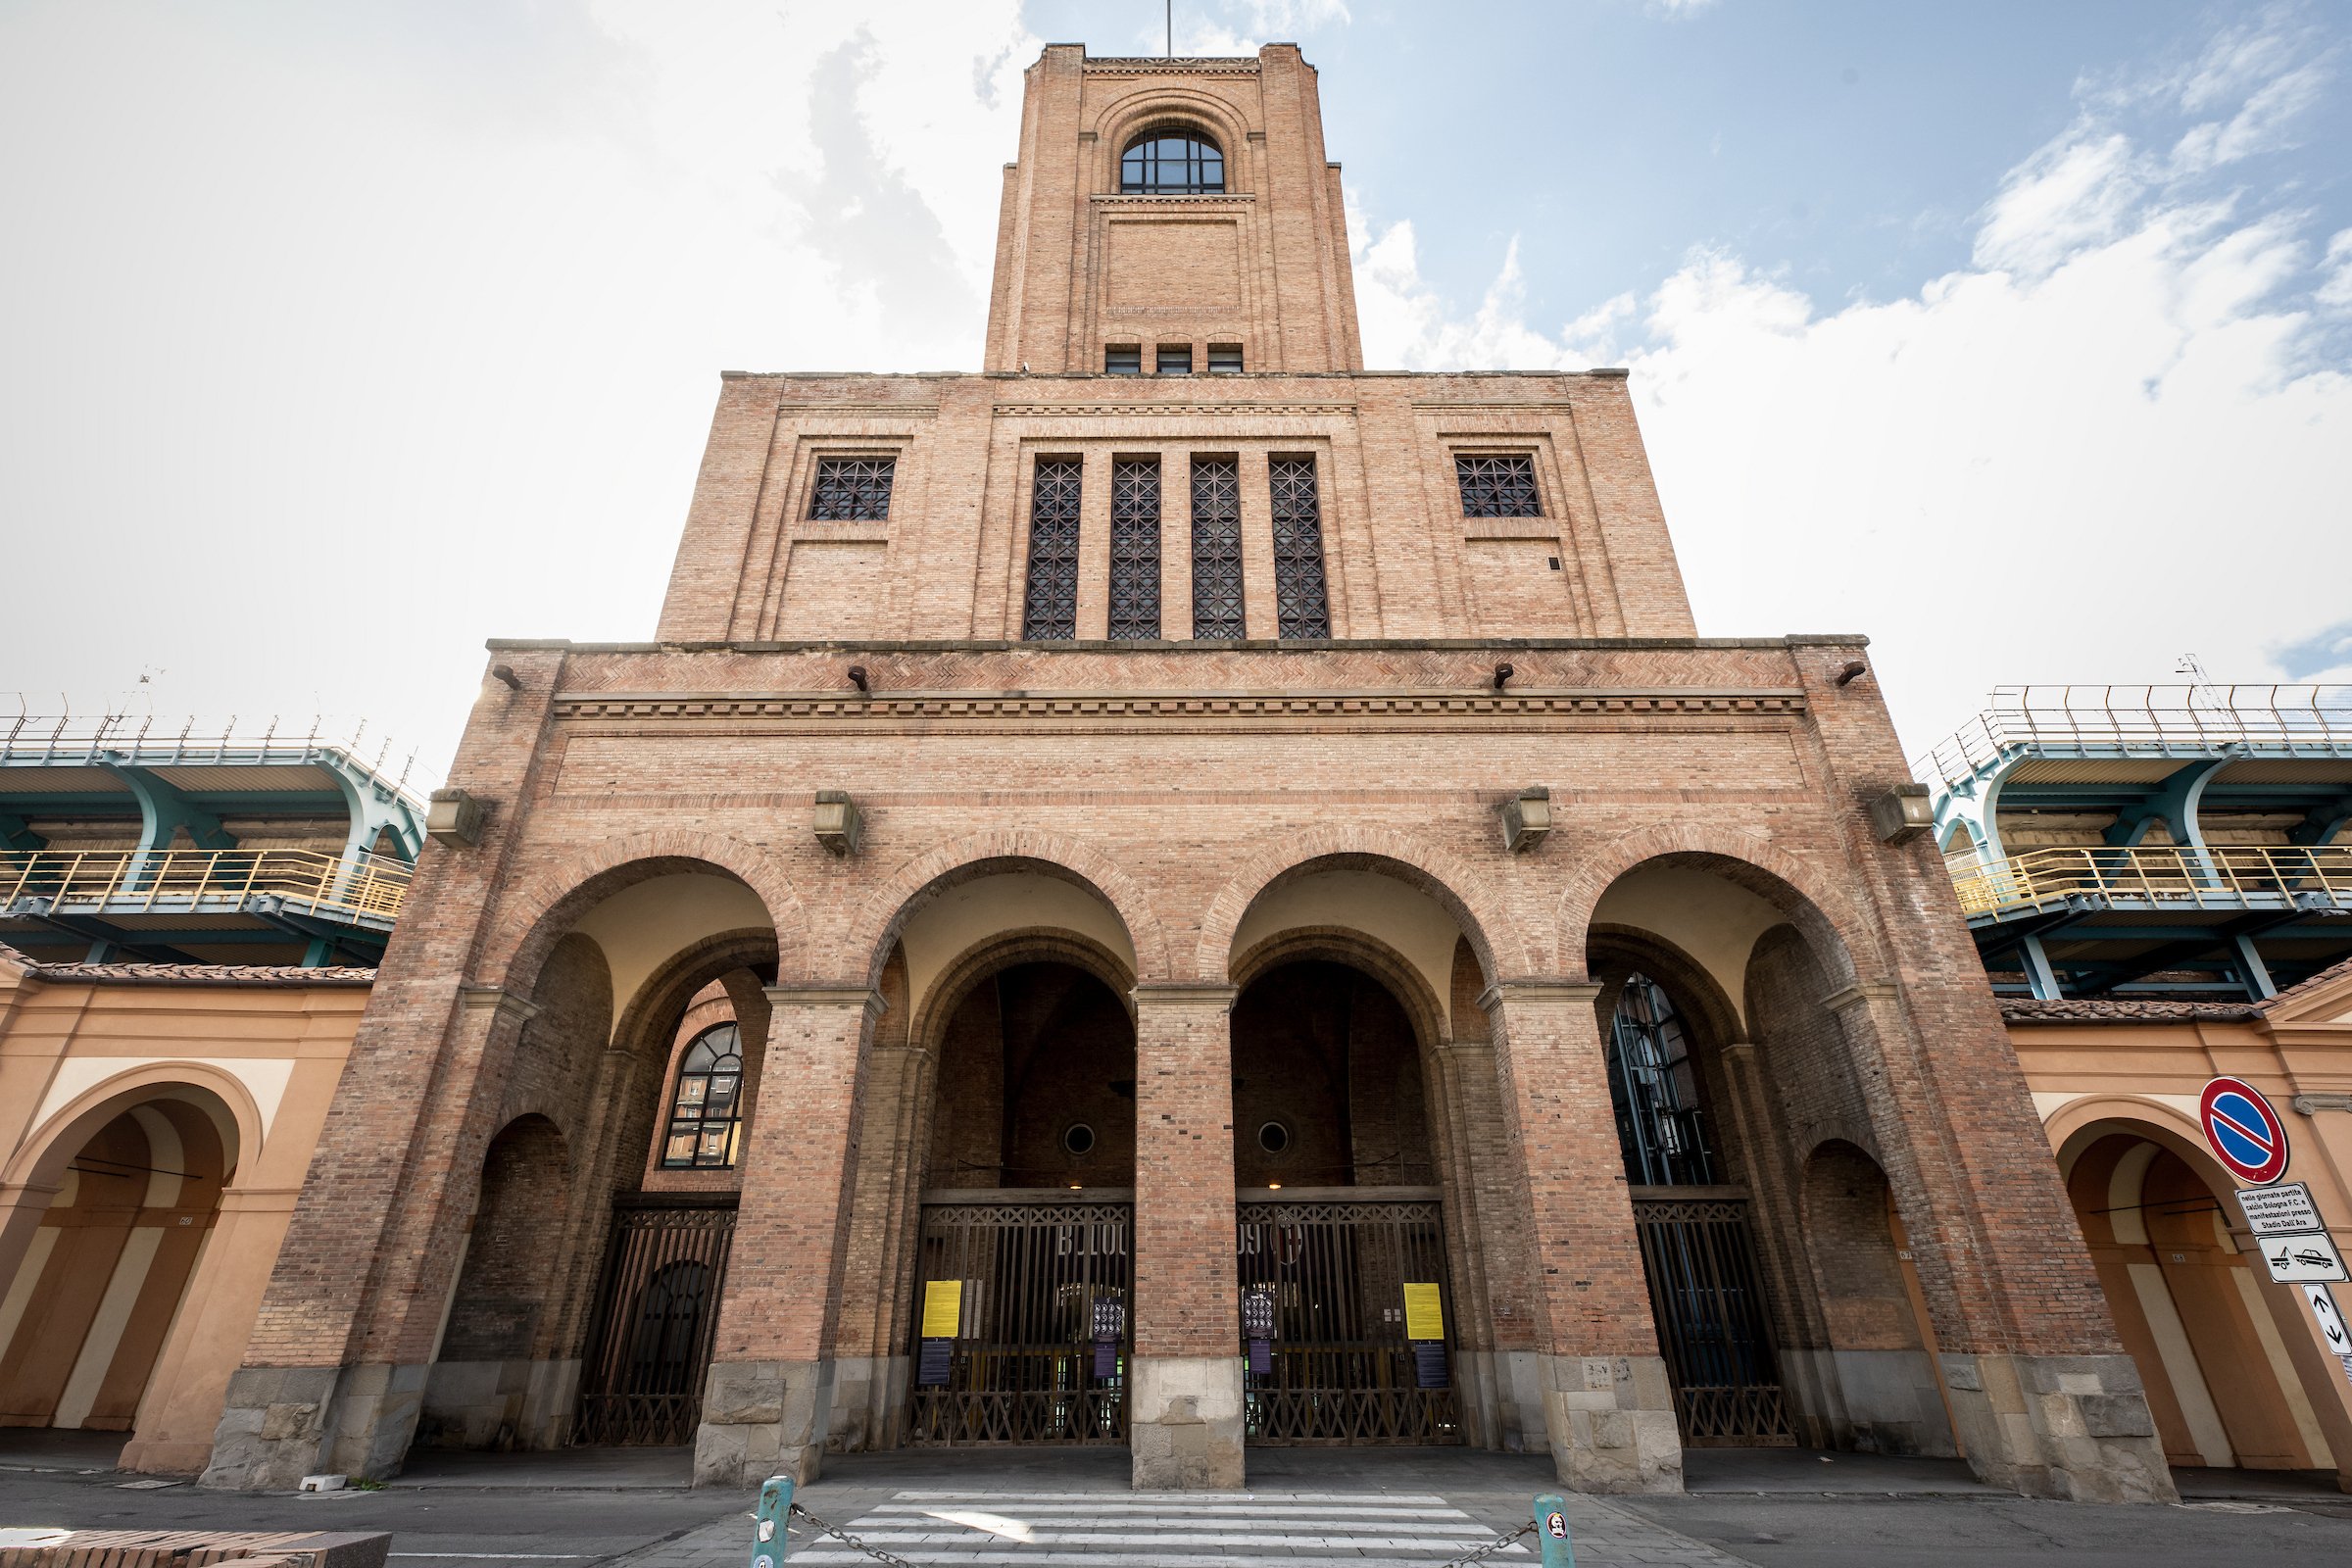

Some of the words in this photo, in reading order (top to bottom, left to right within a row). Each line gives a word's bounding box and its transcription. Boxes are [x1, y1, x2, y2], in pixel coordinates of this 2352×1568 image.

[2256, 1192, 2280, 1201] giornate
[2245, 1201, 2263, 1211] calcio
[2249, 1209, 2291, 1220] manifestazioni
